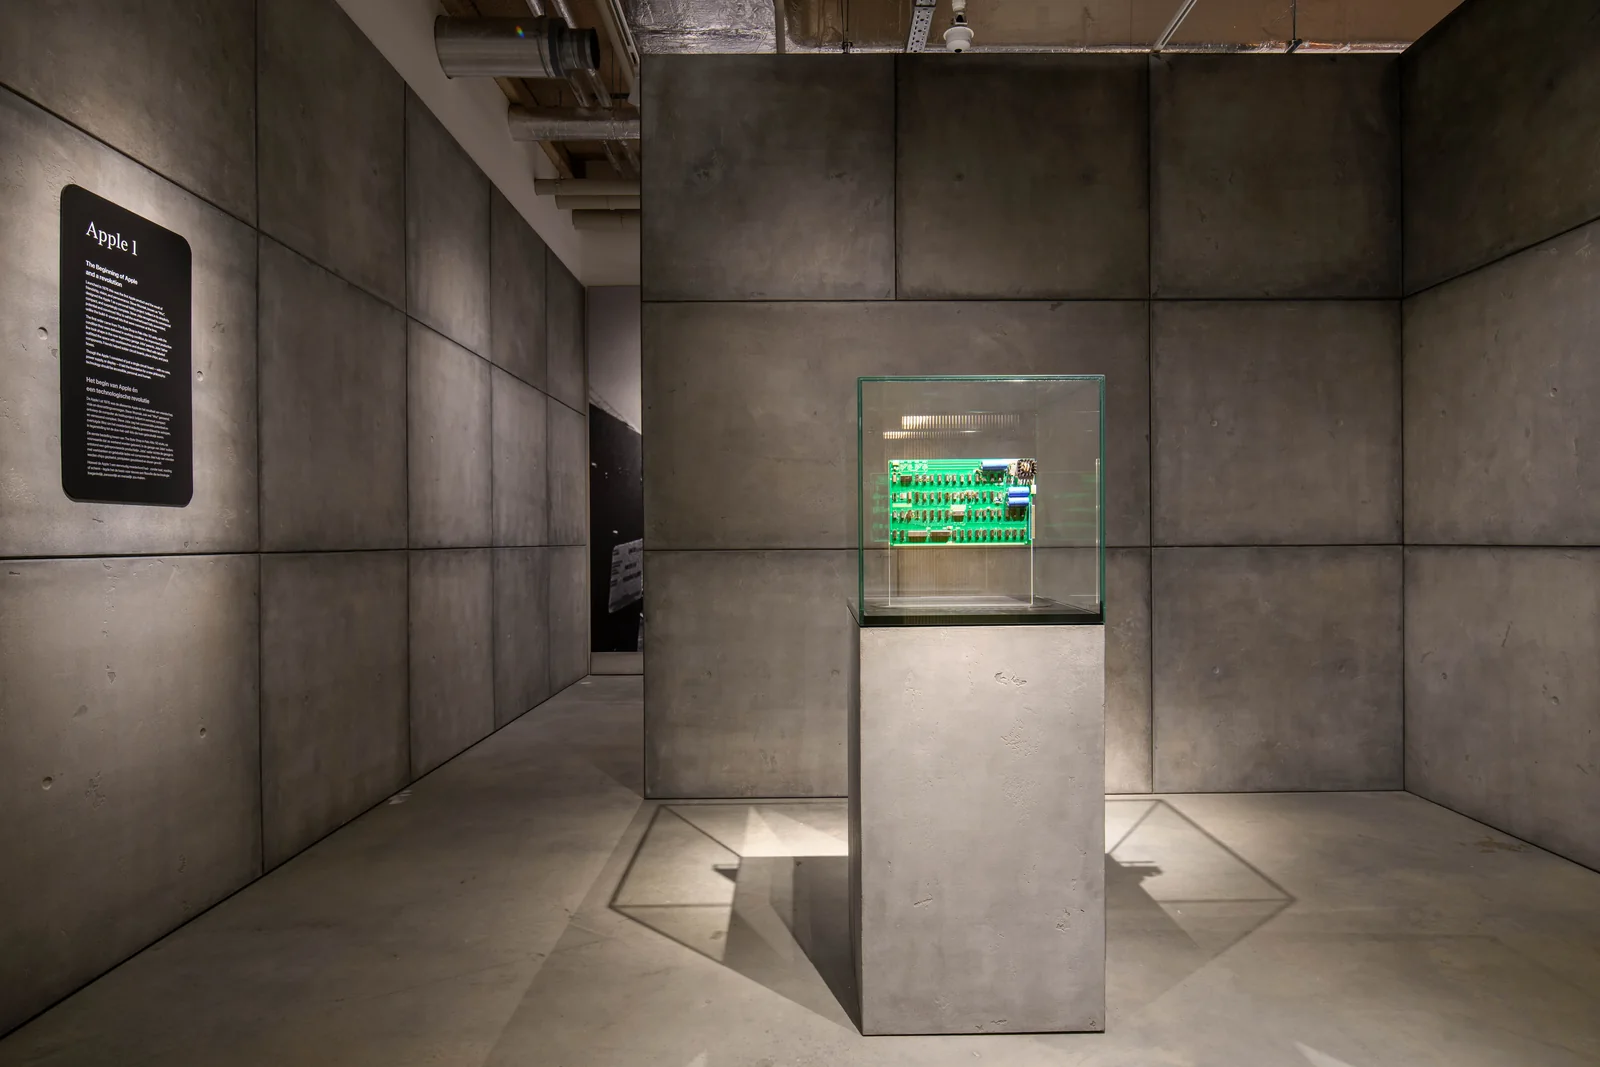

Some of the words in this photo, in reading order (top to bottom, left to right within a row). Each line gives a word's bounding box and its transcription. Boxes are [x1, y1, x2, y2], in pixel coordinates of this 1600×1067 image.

[86, 221, 128, 252] Apple
[86, 260, 95, 268] The
[96, 264, 119, 278] Beginning
[125, 276, 138, 285] Apple
[99, 275, 122, 288] revolution
[96, 379, 109, 387] begin
[96, 388, 131, 400] technologische
[131, 396, 150, 404] revolutie
